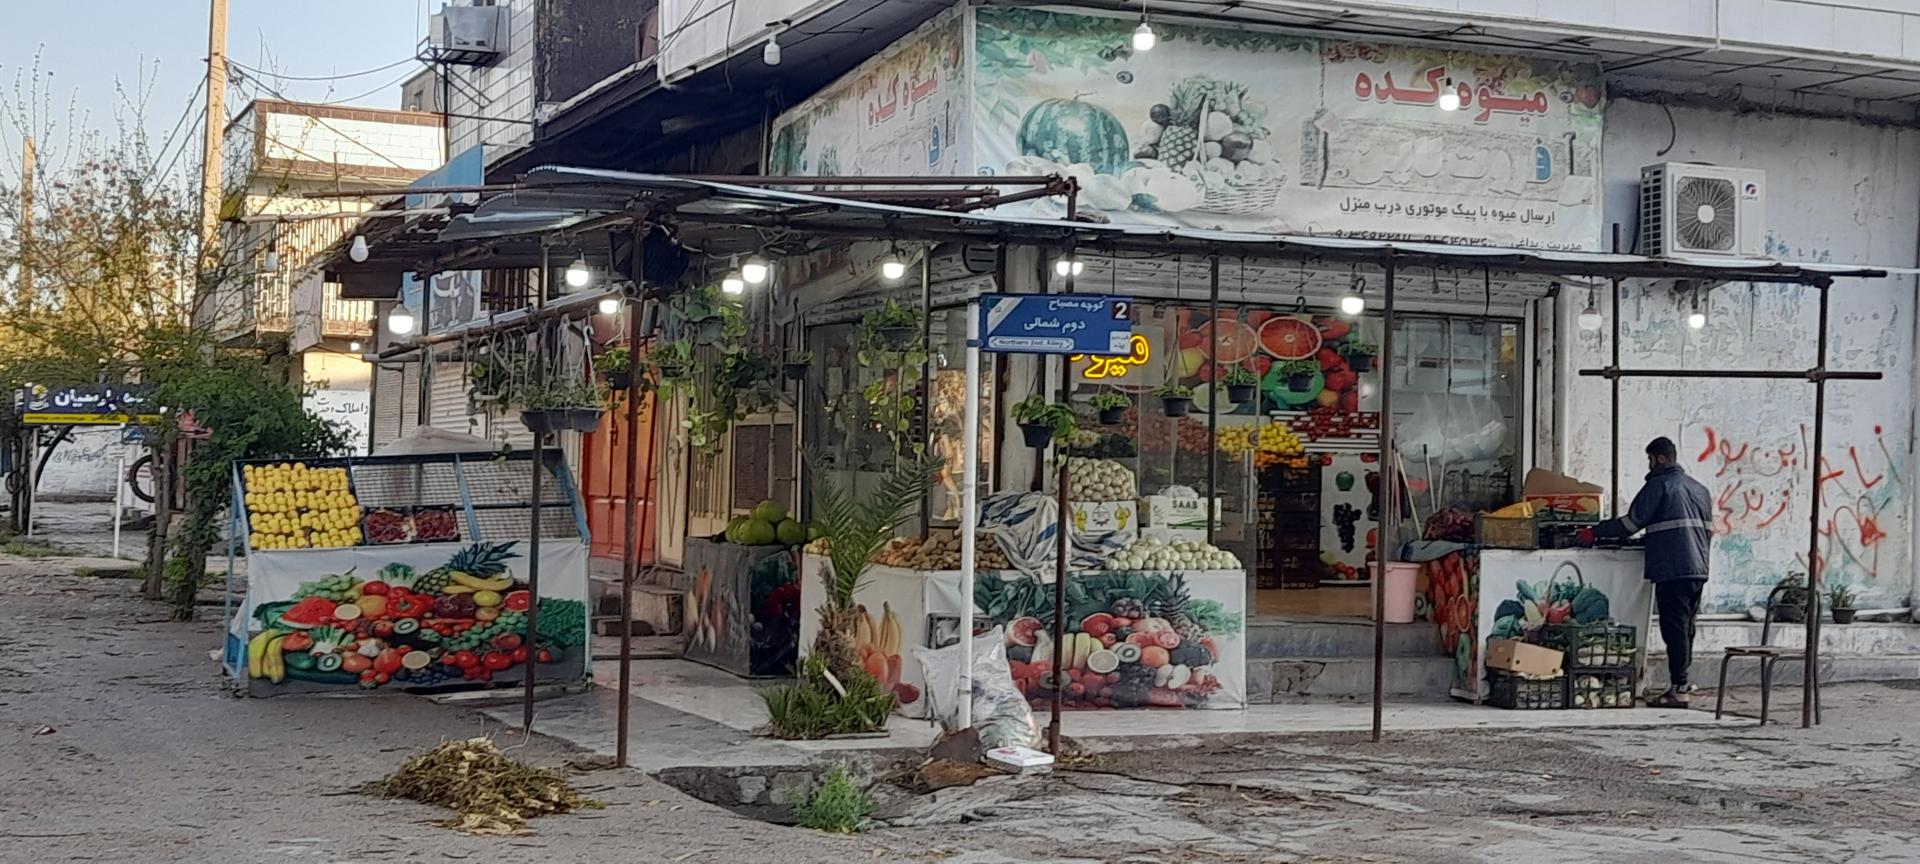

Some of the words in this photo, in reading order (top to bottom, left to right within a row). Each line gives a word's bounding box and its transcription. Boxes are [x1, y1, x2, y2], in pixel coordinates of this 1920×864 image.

[1354, 65, 1447, 106] کده
[1456, 80, 1549, 127] میوه
[1339, 196, 1371, 212] منزل
[1373, 202, 1402, 217] درب
[1404, 202, 1448, 218] موتوری
[1451, 203, 1477, 222] پیک
[1479, 205, 1488, 220] با
[1491, 209, 1517, 222] میوه
[1520, 208, 1555, 225] ارسال
[1048, 299, 1079, 311] مصباح
[1080, 299, 1105, 313] کوچه
[1114, 302, 1128, 320] 2
[1023, 316, 1060, 331] شمالی
[1061, 320, 1087, 334] دوم
[1071, 335, 1150, 378] میو
[1171, 499, 1198, 510] SAAB
